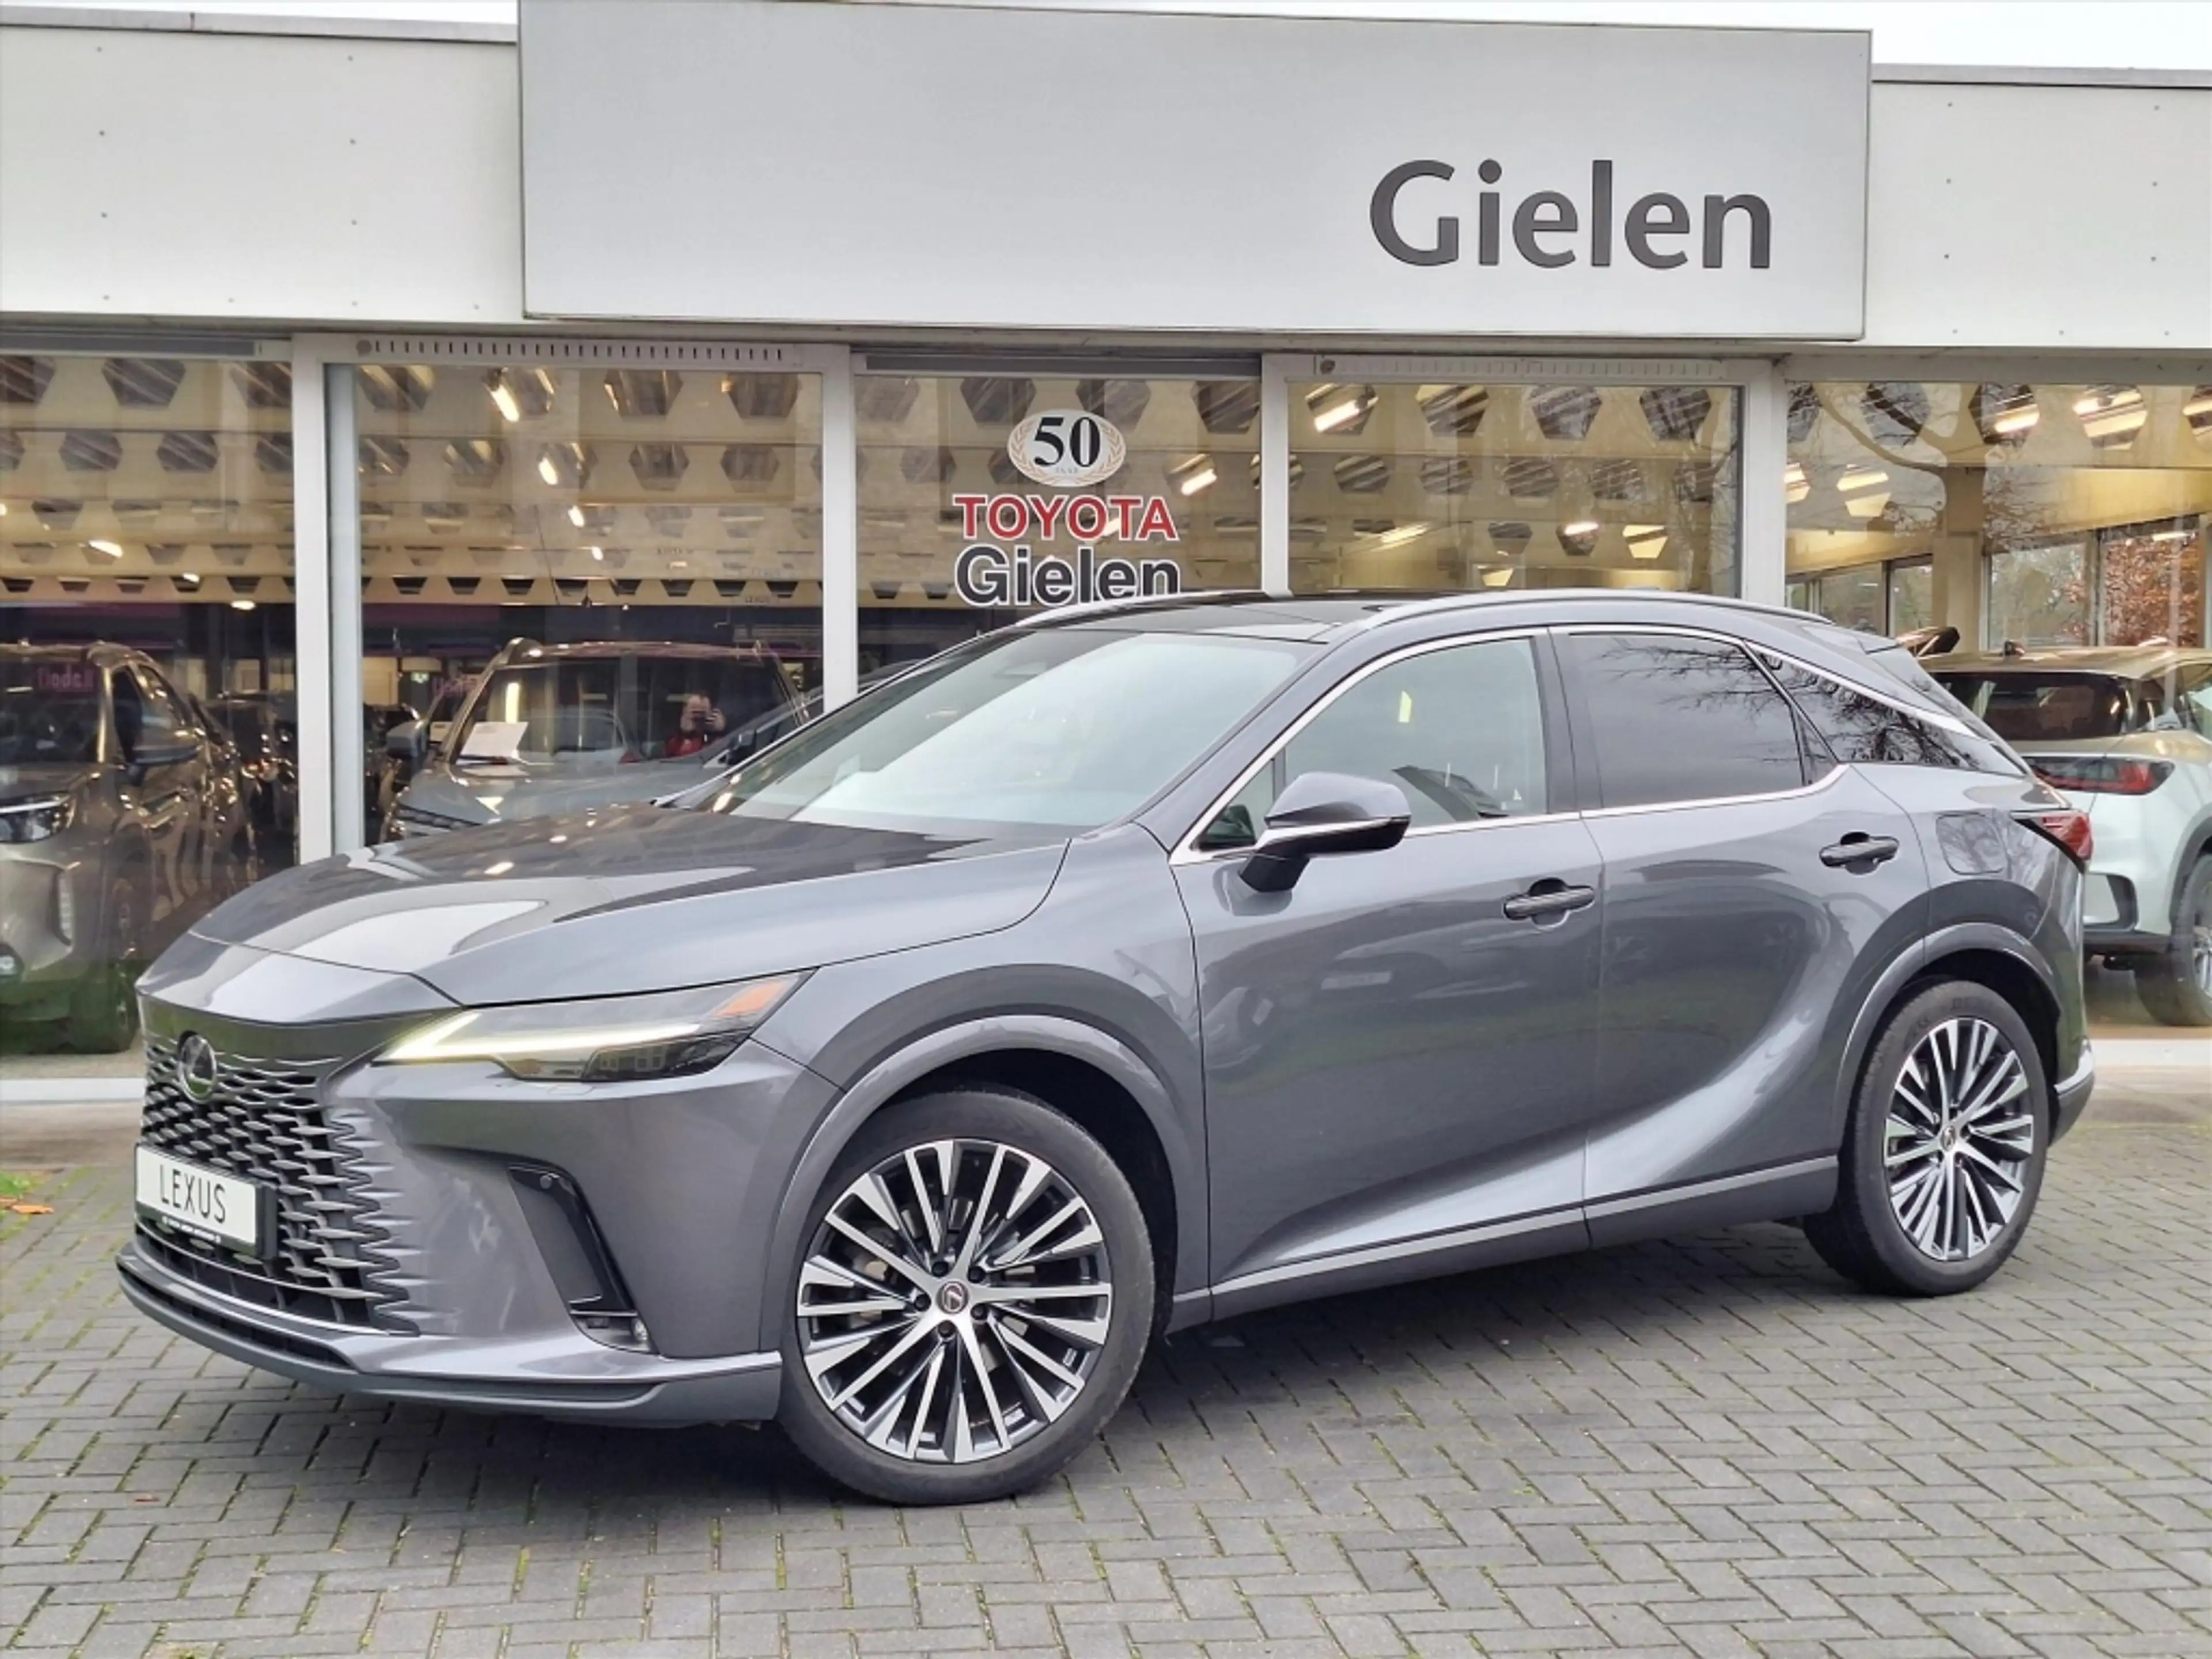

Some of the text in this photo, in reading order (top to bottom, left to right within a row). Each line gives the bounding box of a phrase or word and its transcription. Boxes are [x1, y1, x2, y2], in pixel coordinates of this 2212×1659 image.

[1369, 158, 1771, 269] Gielen
[1034, 416, 1101, 467] 50
[952, 494, 1180, 541] TOYOTA
[955, 543, 1181, 607] Gielen
[160, 1164, 226, 1225] LEXUS
